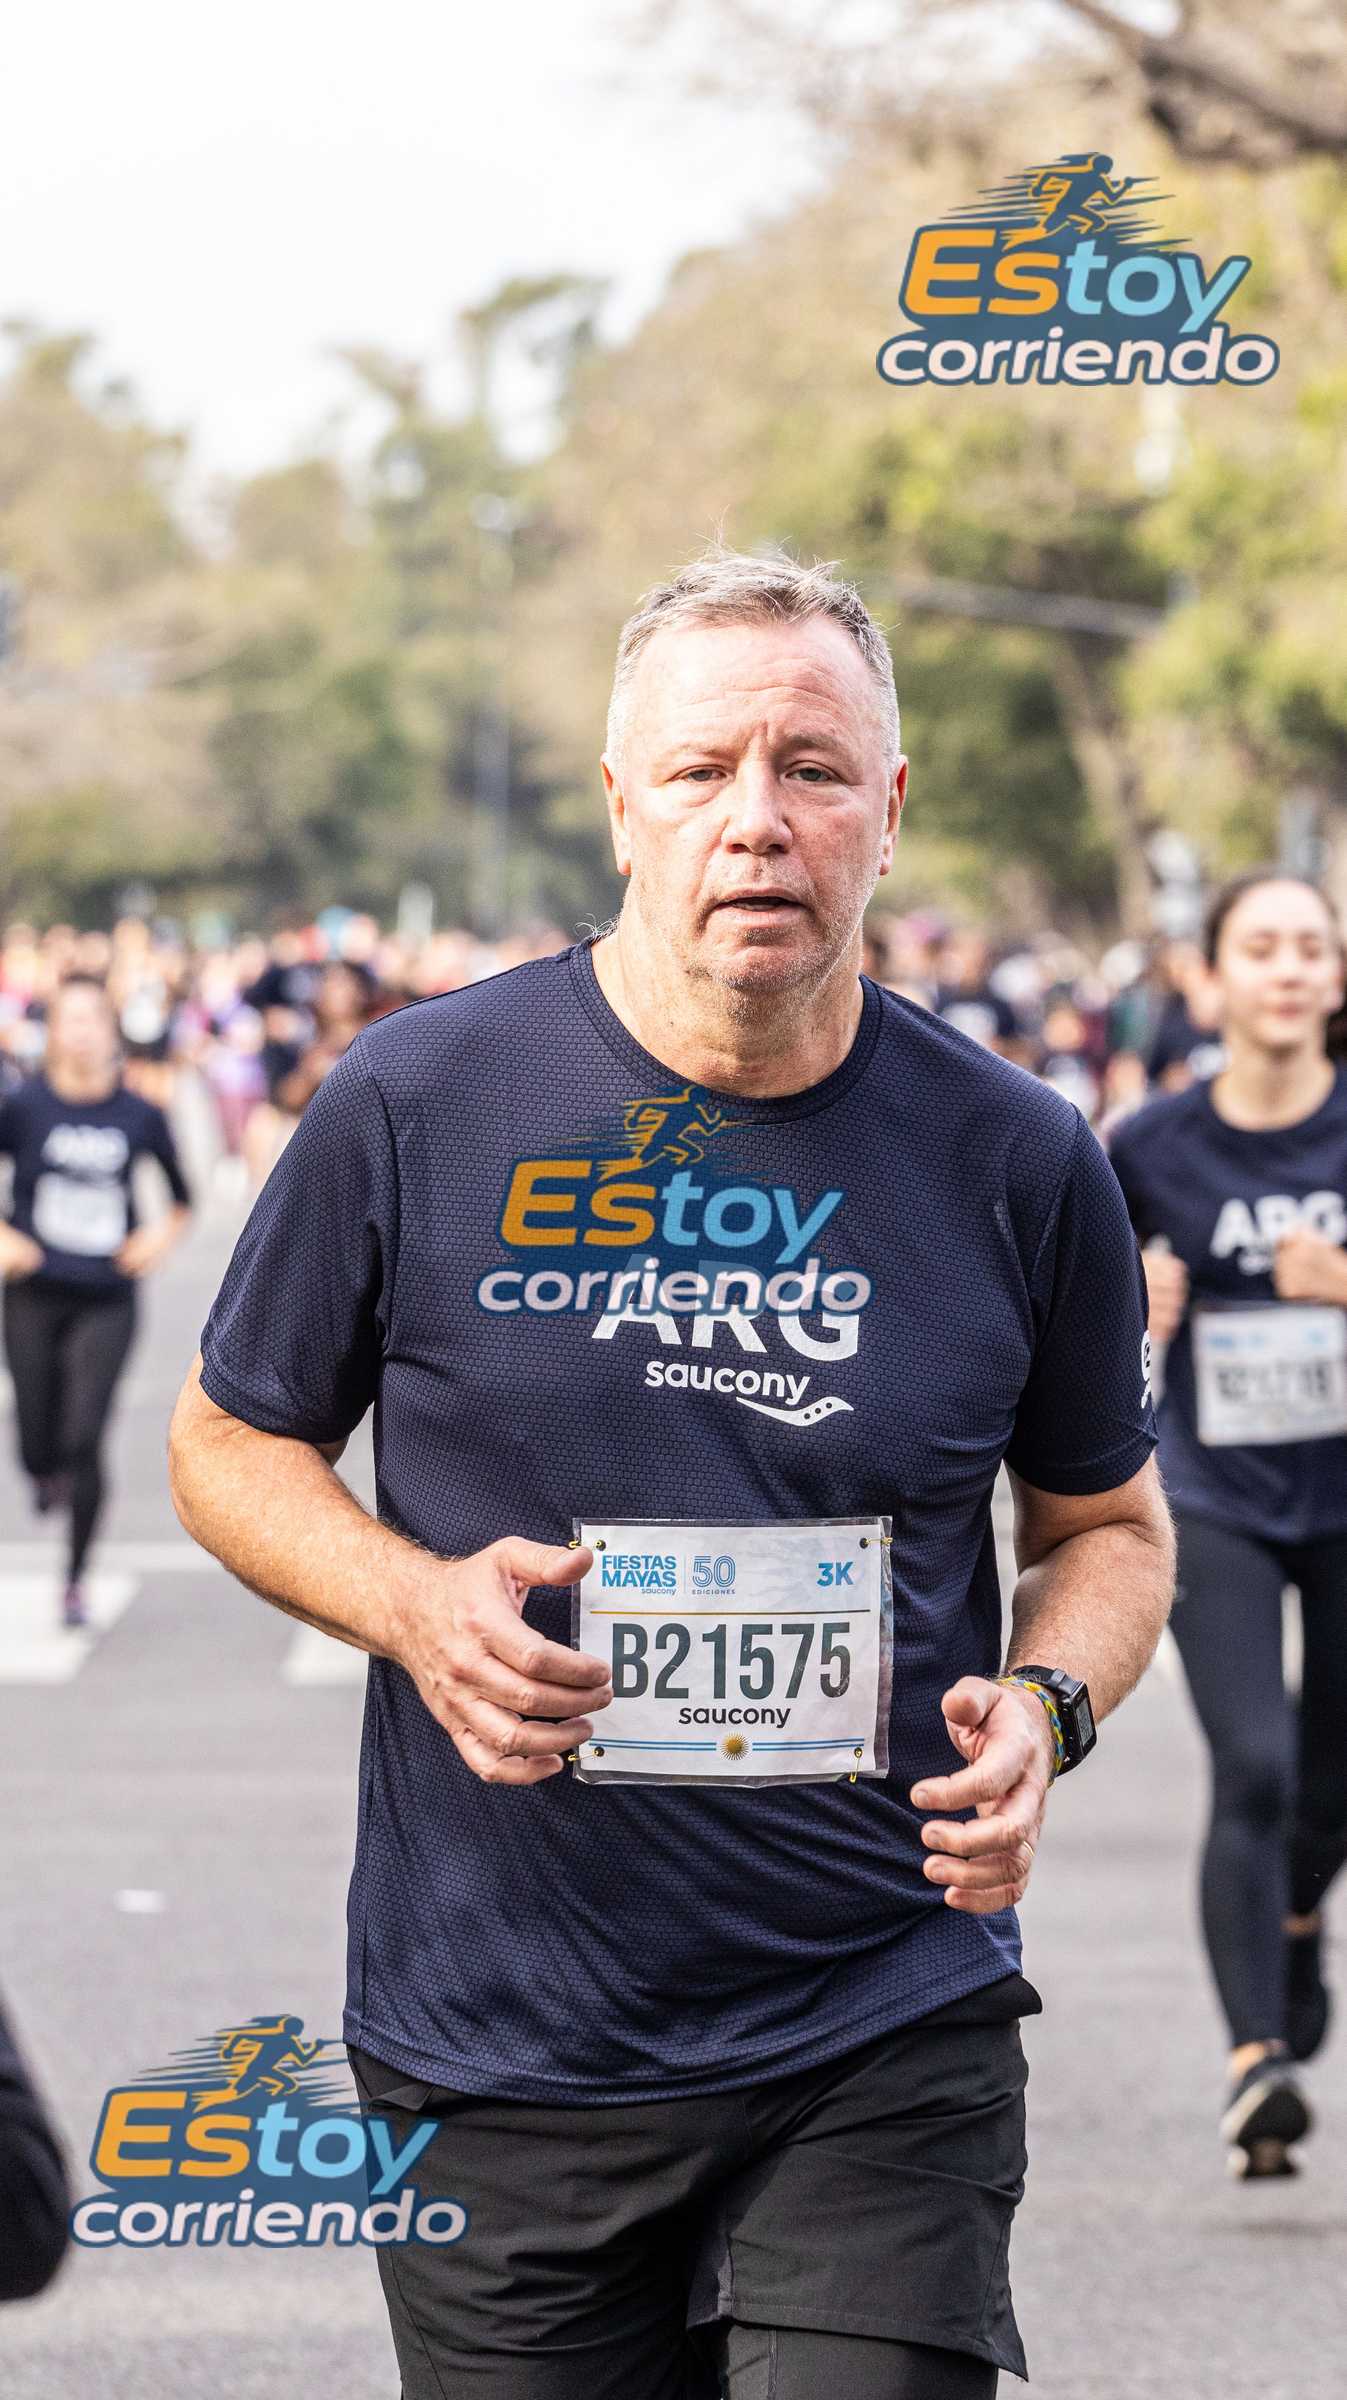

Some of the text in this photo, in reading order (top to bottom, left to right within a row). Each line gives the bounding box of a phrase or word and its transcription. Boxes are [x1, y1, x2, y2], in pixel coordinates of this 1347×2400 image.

[591, 1253, 860, 1361] ARG
[644, 1360, 811, 1405] saucony
[602, 1555, 677, 1569] FIESTAS
[692, 1555, 736, 1588] 50
[817, 1561, 855, 1587] 3K
[602, 1570, 677, 1587] MAYAS
[641, 1588, 677, 1596] saucony
[612, 1621, 851, 1699] B21575
[678, 1706, 791, 1729] saucony
